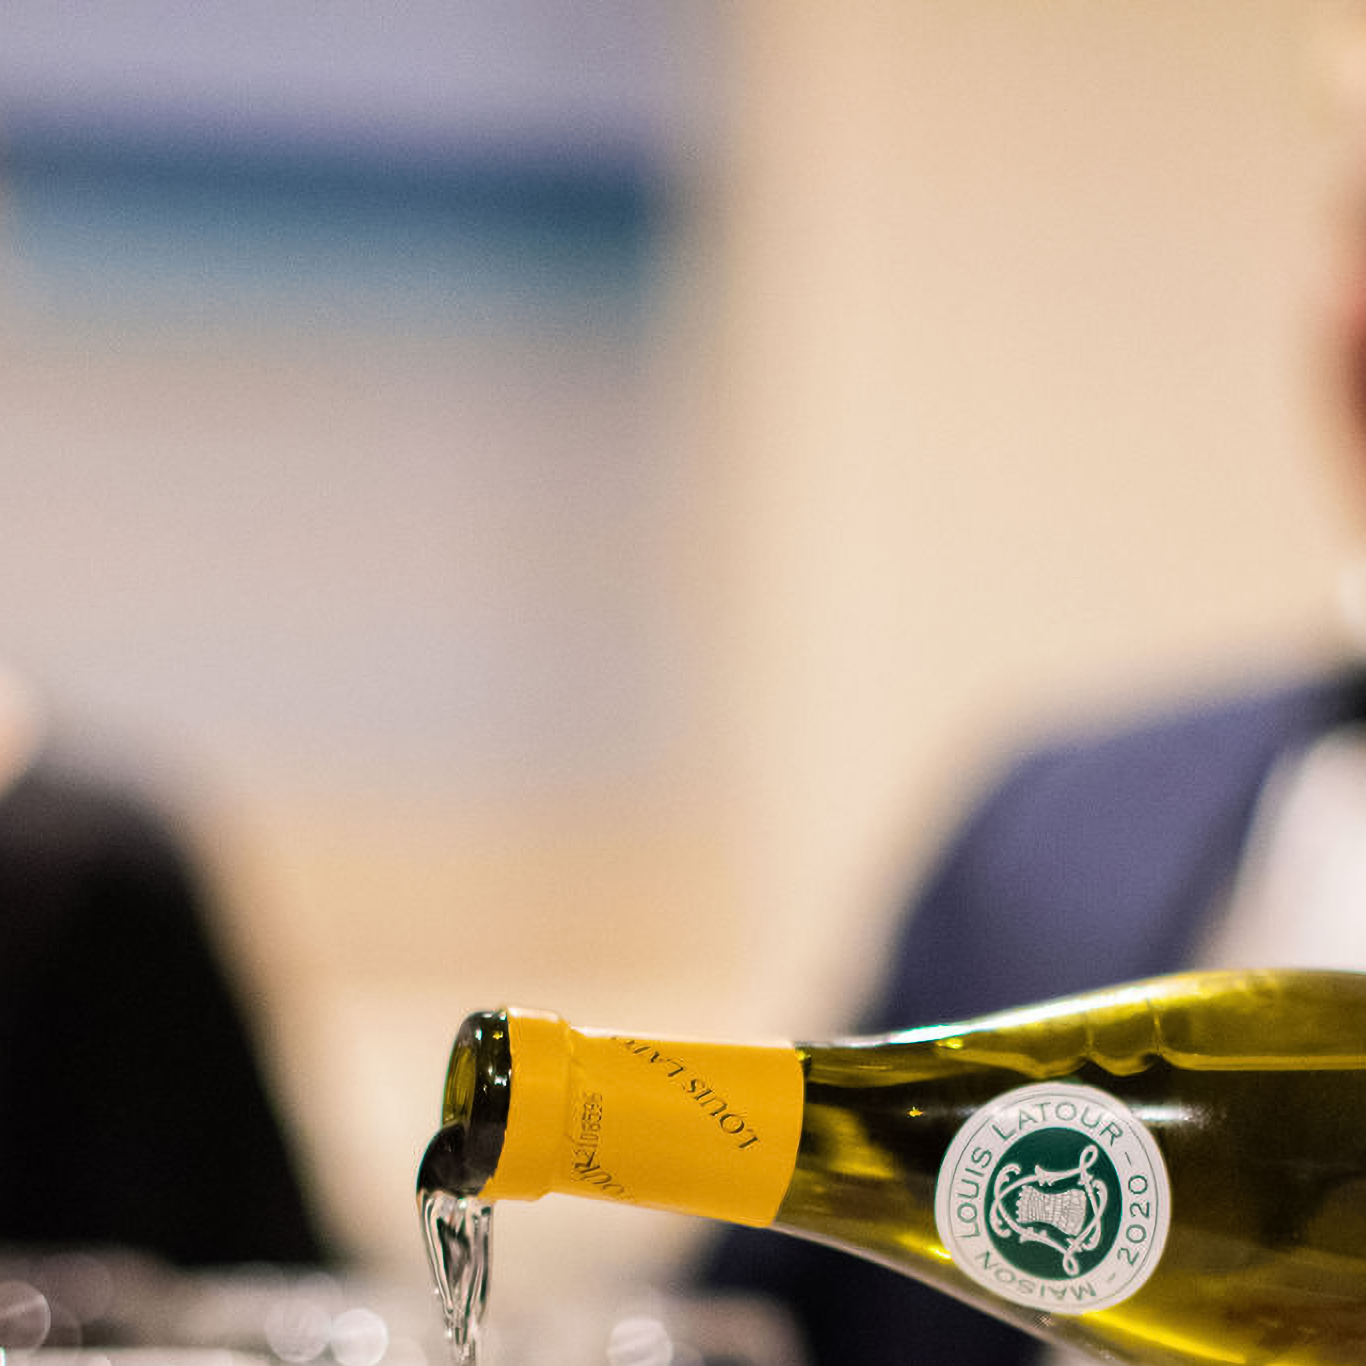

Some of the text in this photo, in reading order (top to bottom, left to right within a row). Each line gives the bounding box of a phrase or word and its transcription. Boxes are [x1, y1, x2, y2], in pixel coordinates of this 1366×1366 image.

[682, 1077, 761, 1150] LOUIS
[955, 1102, 1151, 1301] MAISON LOUIS LATOUR 2020
